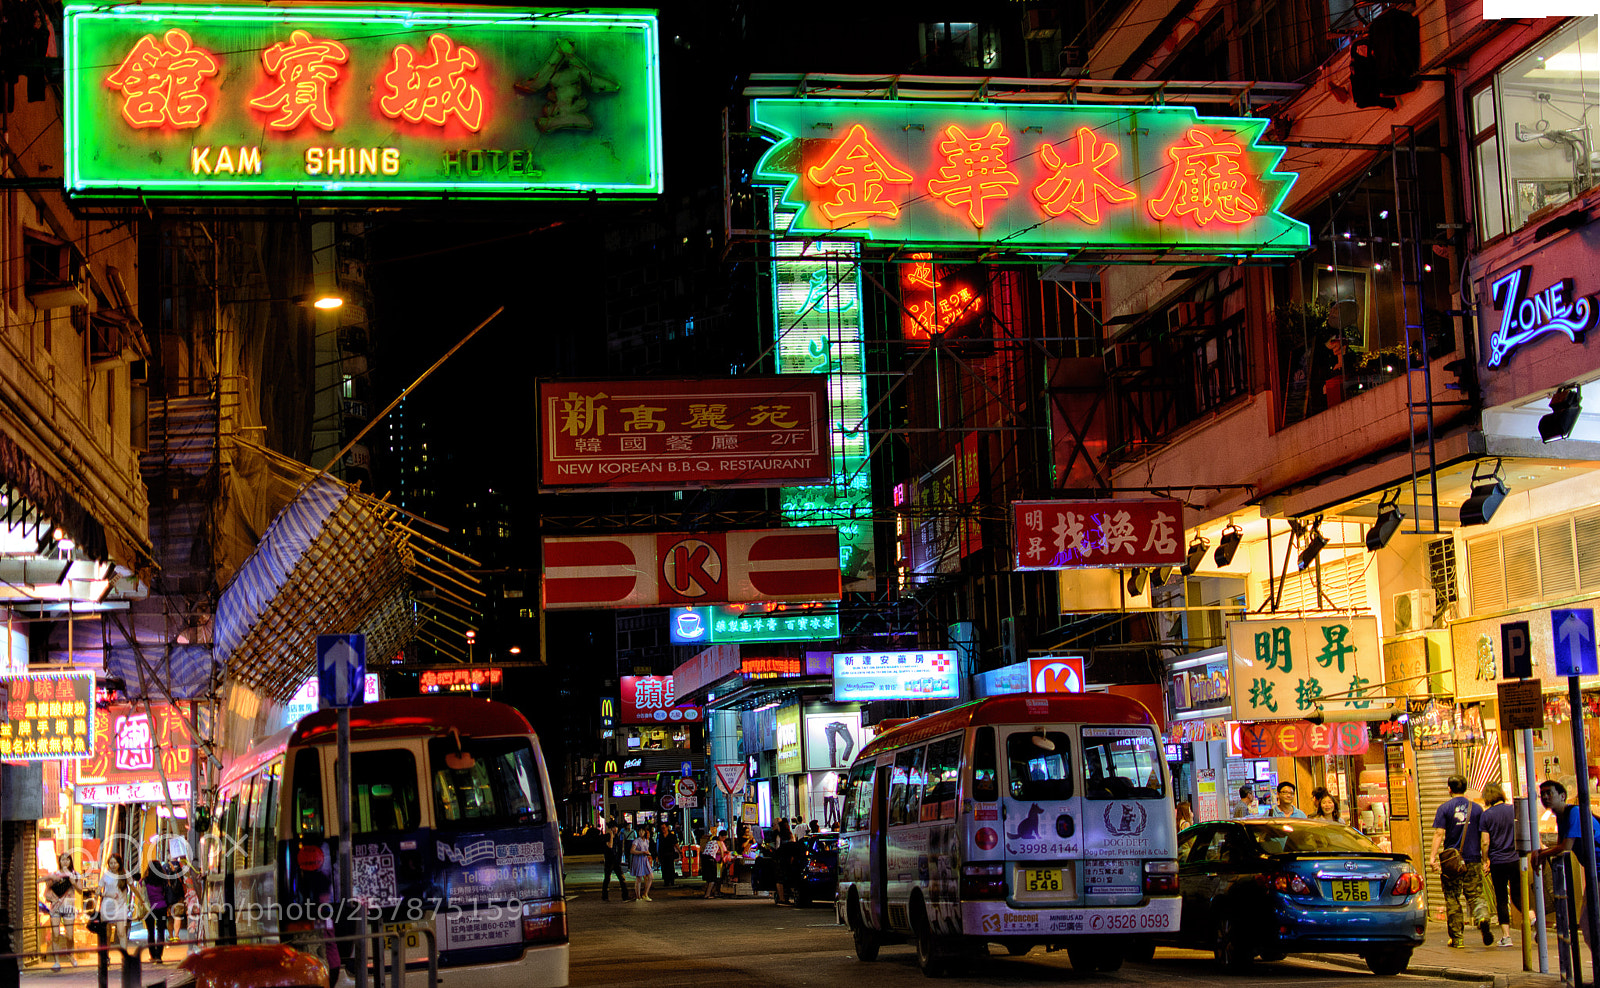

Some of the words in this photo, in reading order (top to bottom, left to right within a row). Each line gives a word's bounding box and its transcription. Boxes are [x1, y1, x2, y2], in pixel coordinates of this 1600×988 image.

[191, 146, 262, 176] KAM
[304, 147, 400, 175] SHING
[443, 149, 543, 178] HOTEL
[807, 122, 1258, 227] 金華冰廳
[939, 287, 972, 314] 足の裏
[574, 434, 739, 454] 韓國餐廳
[770, 432, 805, 446] 2/F
[557, 463, 594, 475] NEW
[597, 461, 662, 474] KOREAN
[667, 459, 714, 472] B.B.Q.
[719, 458, 812, 471] RESTAURANT
[1025, 509, 1046, 561] 明昇
[1051, 509, 1178, 557] 找換店
[674, 545, 721, 594] K
[1254, 624, 1358, 674] 明昇
[1507, 628, 1526, 673] P
[1044, 667, 1072, 693] K
[1189, 673, 1221, 701] Circle
[1248, 675, 1370, 713] 找換店
[1250, 728, 1267, 753] ¥
[1277, 725, 1298, 751] €
[1310, 723, 1330, 750] £
[1342, 723, 1360, 750] $
[355, 842, 392, 856] 即登入
[1019, 843, 1049, 854] 3998
[1050, 843, 1078, 854] 4144
[1103, 838, 1124, 846] DOG
[1084, 849, 1098, 857] Dog
[511, 866, 537, 880] 6178
[1036, 870, 1052, 880] EG
[1030, 880, 1059, 890] 548
[1342, 880, 1359, 891] EE
[1335, 890, 1368, 900] 2768
[1003, 913, 1039, 923] QConcept
[1049, 921, 1084, 931] 小巴廣告
[1106, 915, 1136, 928] 3526
[1140, 914, 1170, 927] 0593
